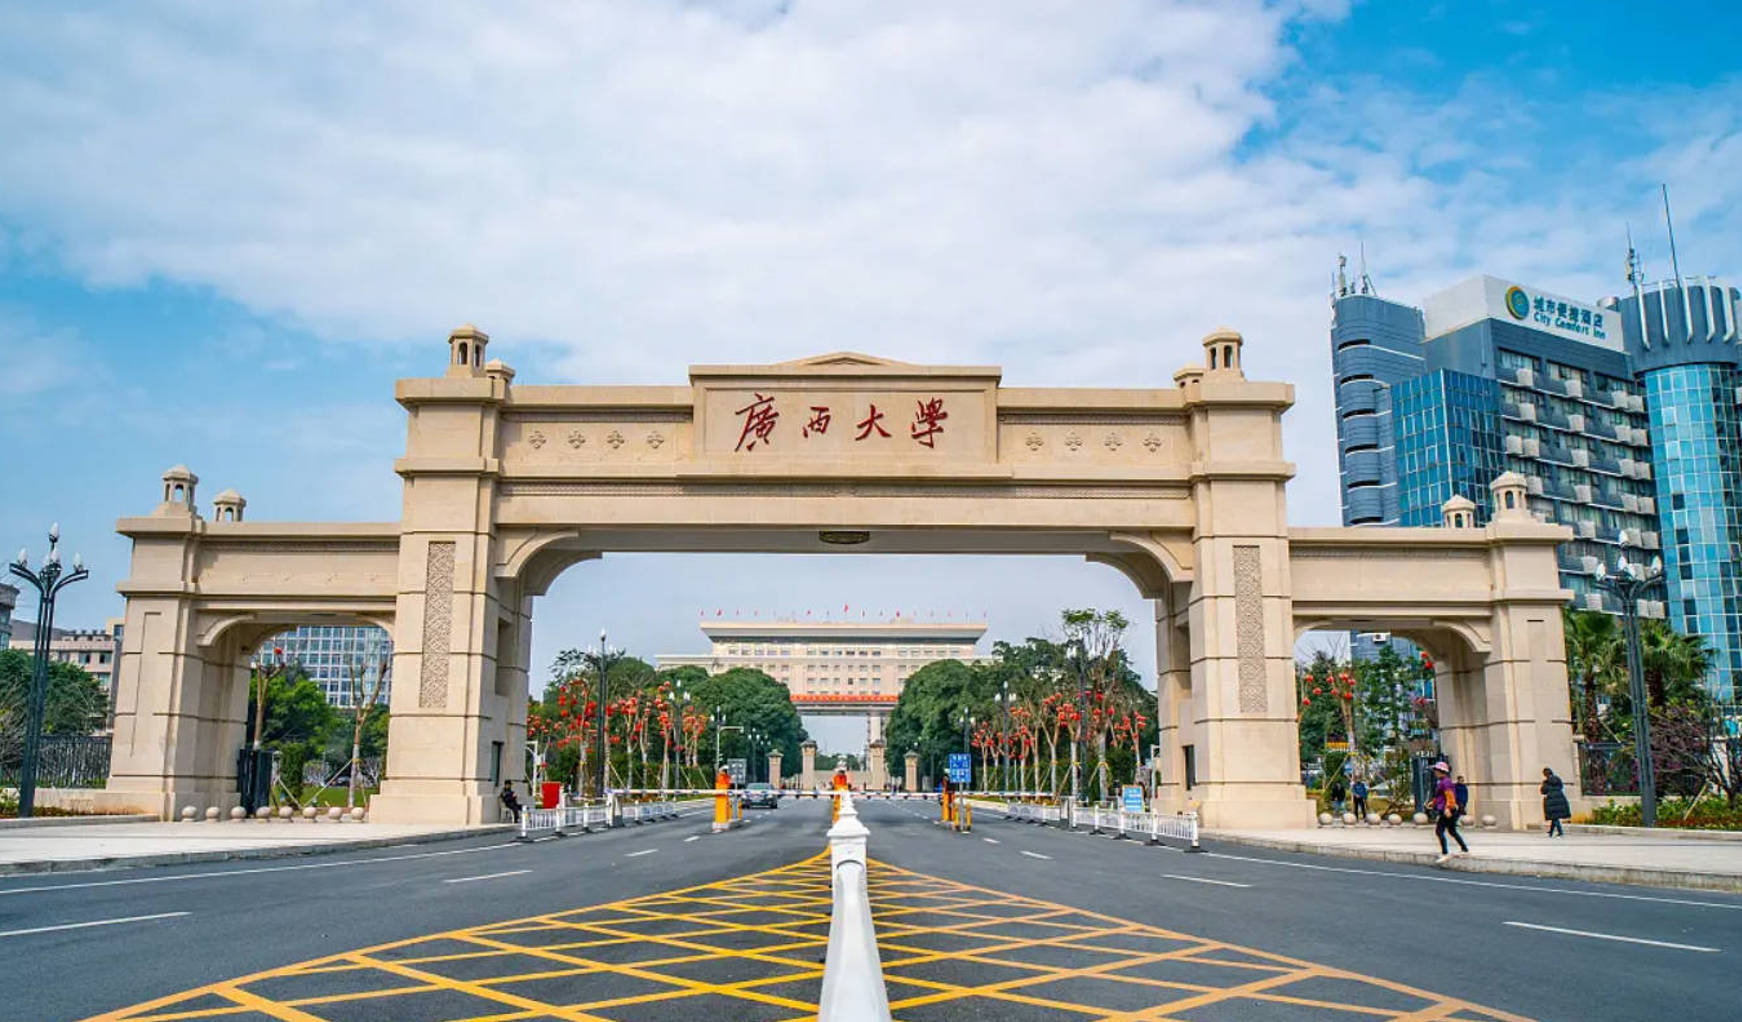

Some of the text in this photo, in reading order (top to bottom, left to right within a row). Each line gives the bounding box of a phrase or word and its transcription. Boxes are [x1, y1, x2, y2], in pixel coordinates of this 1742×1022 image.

[1534, 312, 1606, 338] City Comfort Inn
[735, 393, 948, 452] 廣西大學
